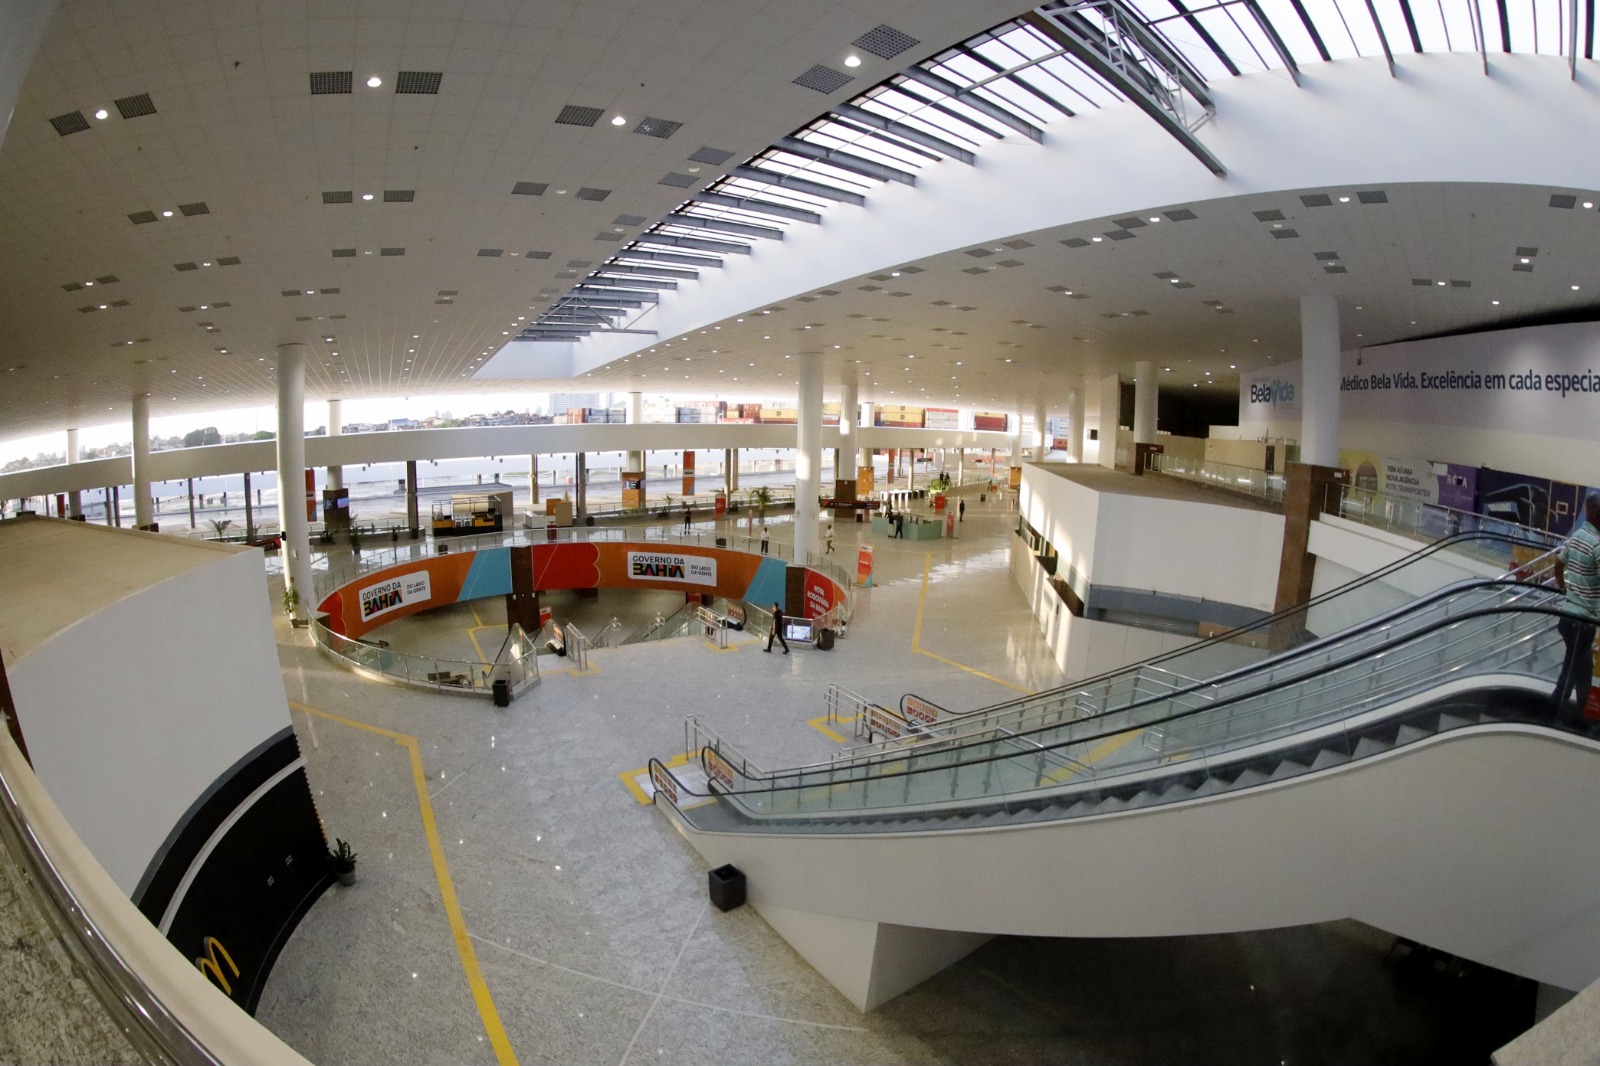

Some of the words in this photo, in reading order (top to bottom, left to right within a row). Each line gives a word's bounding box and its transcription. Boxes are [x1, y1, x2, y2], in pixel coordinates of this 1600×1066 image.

[1371, 373, 1391, 389] Bela
[1393, 372, 1418, 389] Vida.
[1421, 369, 1481, 389] Excelência
[1485, 374, 1505, 389] em
[1509, 369, 1542, 390] cada
[1545, 369, 1600, 398] especia
[632, 555, 672, 564] GOVERNO
[674, 557, 685, 565] DA
[633, 563, 685, 578] BAHIA
[363, 583, 391, 601] GOVERNO
[392, 581, 402, 590] DA
[413, 586, 426, 594] GENTE
[363, 589, 403, 617] BAHIA
